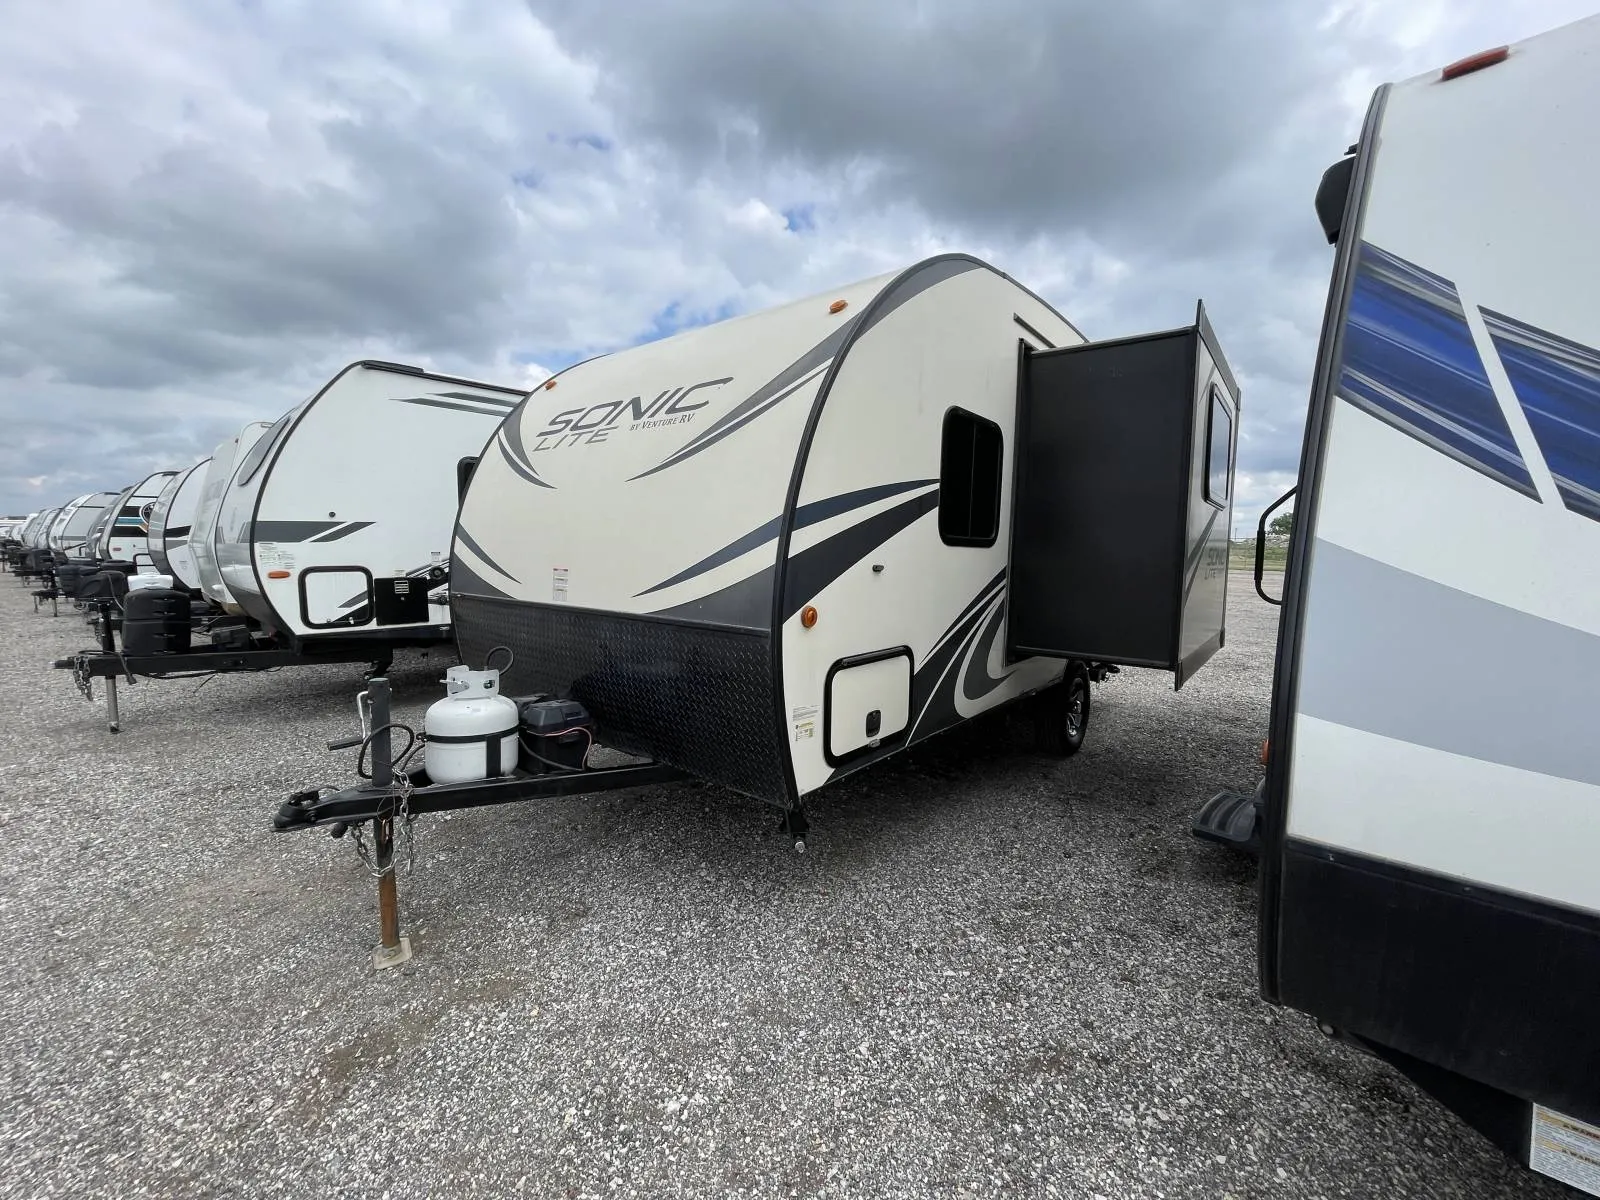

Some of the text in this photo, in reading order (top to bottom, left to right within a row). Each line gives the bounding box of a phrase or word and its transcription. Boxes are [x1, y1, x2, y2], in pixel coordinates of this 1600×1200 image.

[536, 376, 734, 437] SONIC
[679, 413, 695, 424] RV
[533, 425, 619, 452] LITE
[1206, 547, 1226, 567] SONIC
